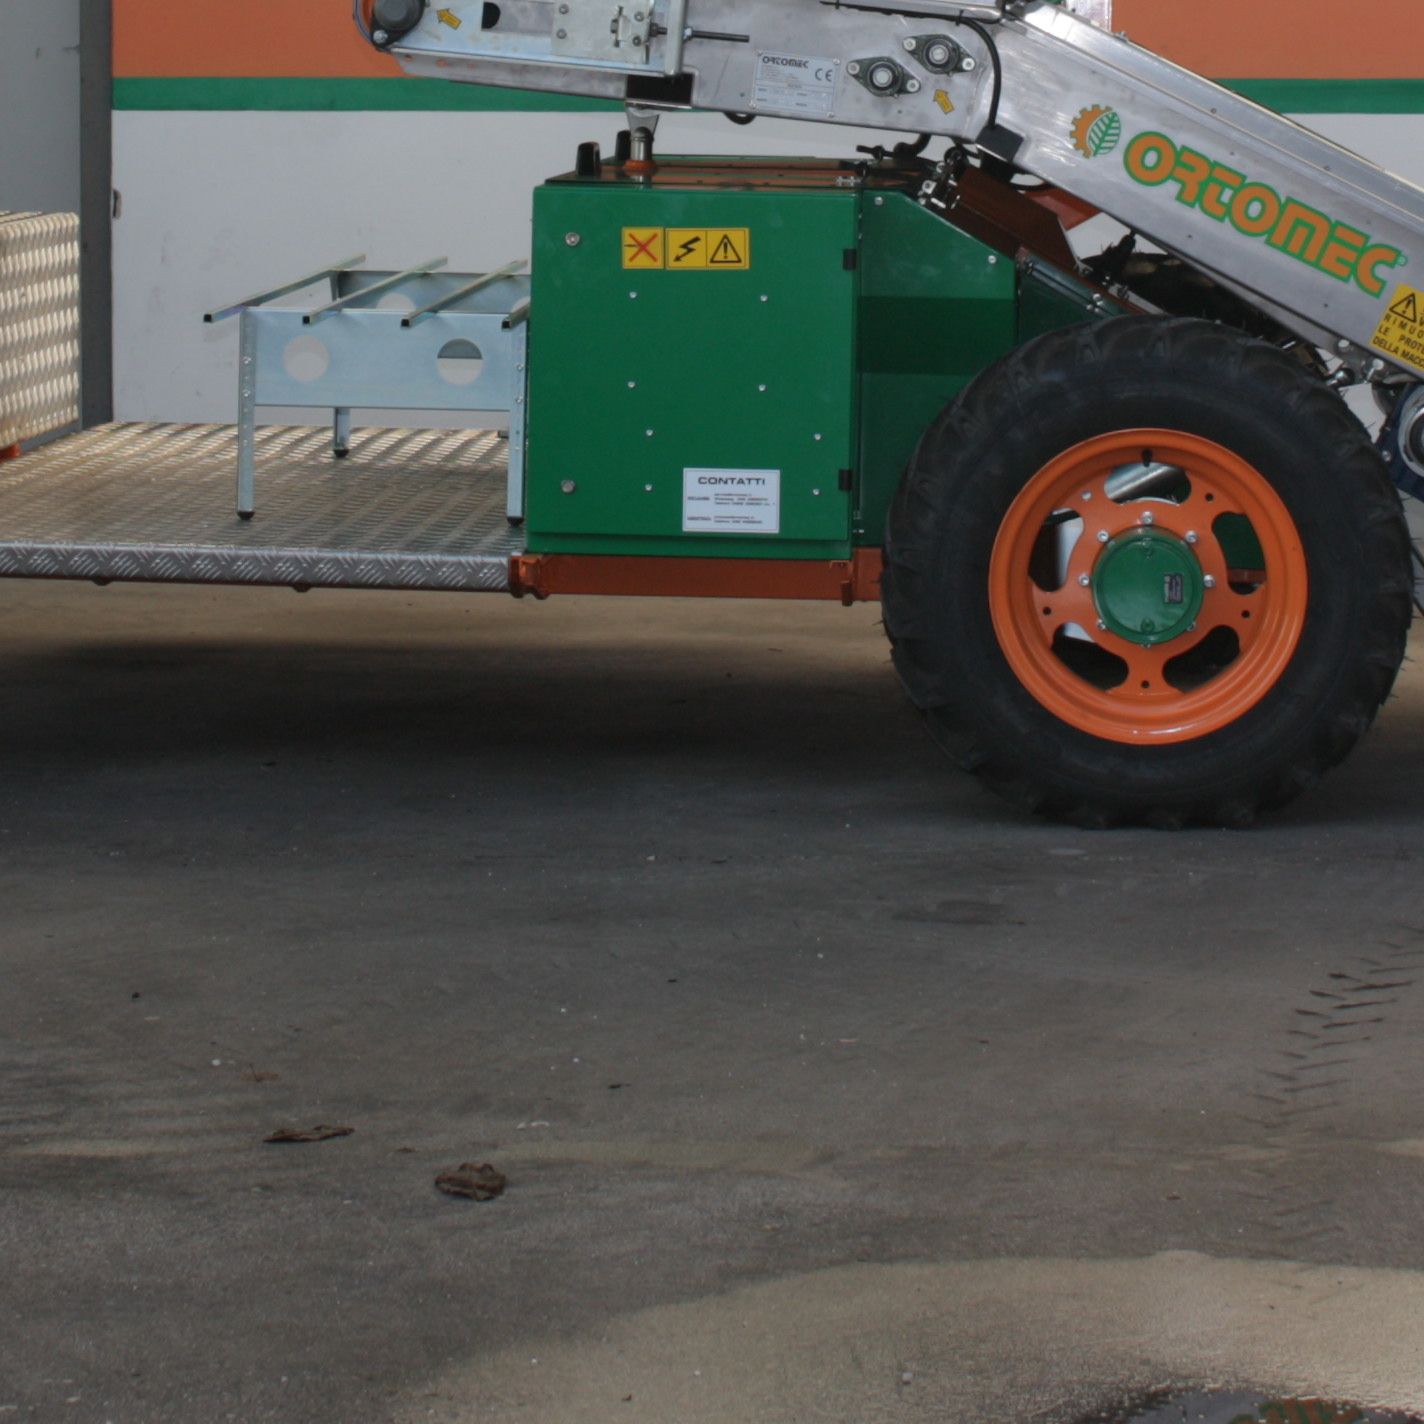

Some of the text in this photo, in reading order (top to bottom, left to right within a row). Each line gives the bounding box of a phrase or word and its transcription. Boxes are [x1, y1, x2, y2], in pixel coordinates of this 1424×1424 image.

[815, 68, 833, 82] CE
[1123, 131, 1404, 299] ORTOMEC
[1378, 325, 1390, 335] LE
[1372, 336, 1399, 355] DELLA
[697, 476, 766, 486] CONTATTI
